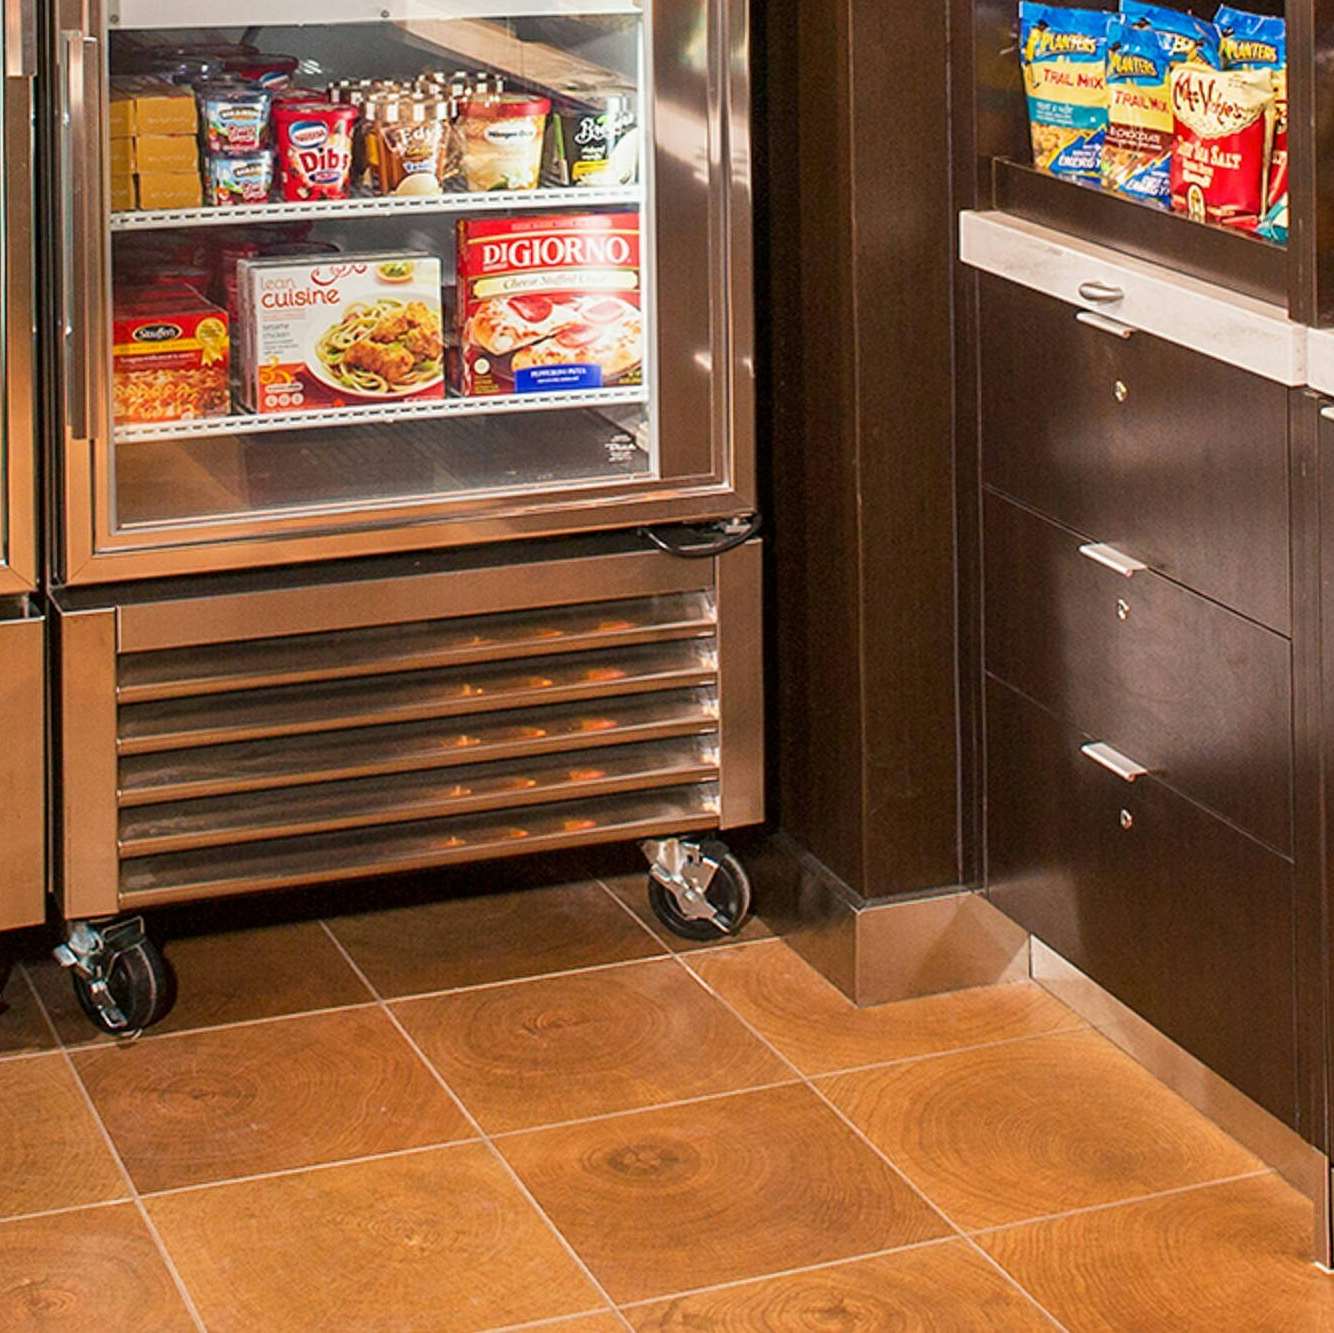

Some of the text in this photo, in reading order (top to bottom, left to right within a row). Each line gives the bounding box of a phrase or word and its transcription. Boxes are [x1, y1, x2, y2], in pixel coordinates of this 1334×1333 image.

[1041, 29, 1097, 53] PLANTERS
[1226, 39, 1278, 62] PLANTERS
[1109, 54, 1158, 77] PLANTERS
[1042, 67, 1105, 91] TRAIL MIX
[1114, 90, 1170, 114] TRAIL MIX
[299, 148, 349, 173] Dibs
[1210, 144, 1243, 170] SALT
[260, 276, 298, 291] lean
[501, 273, 578, 291] Cheese Stuffed
[260, 286, 340, 309] cuisine
